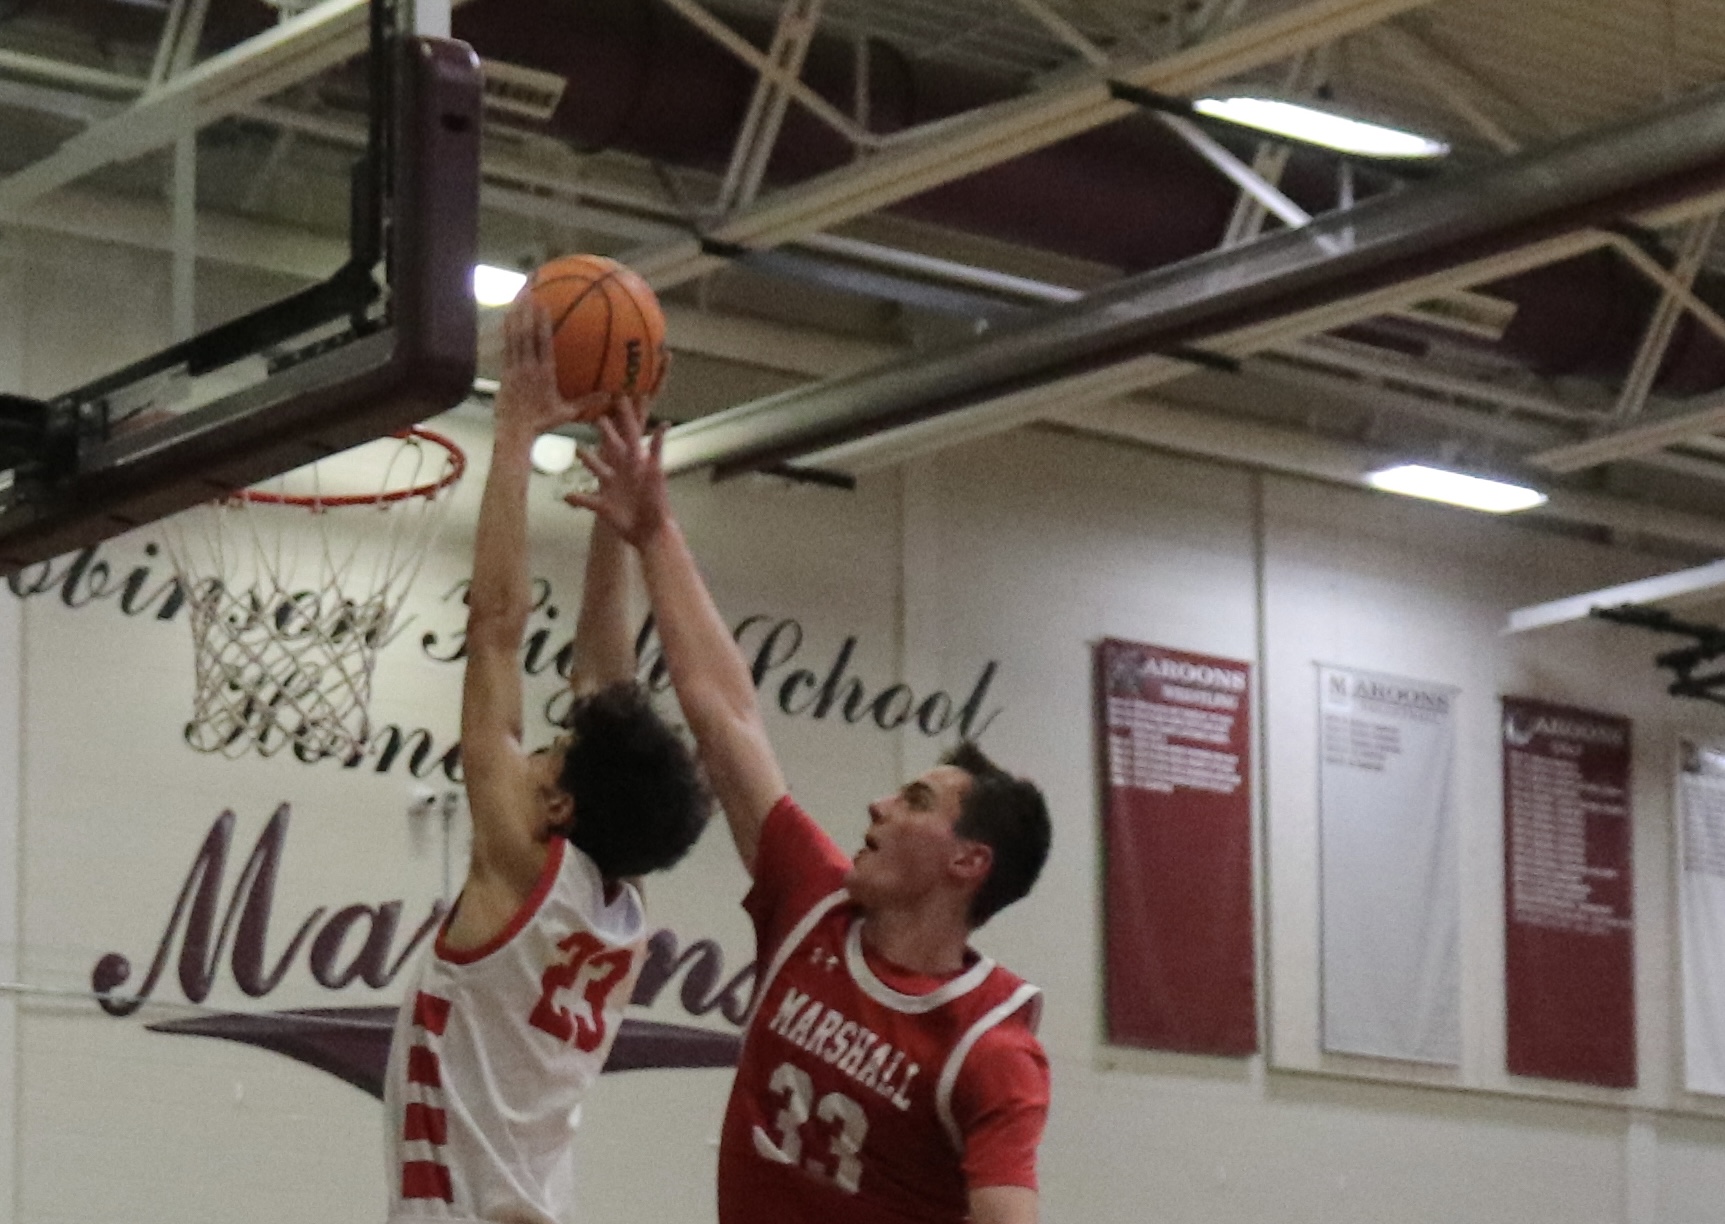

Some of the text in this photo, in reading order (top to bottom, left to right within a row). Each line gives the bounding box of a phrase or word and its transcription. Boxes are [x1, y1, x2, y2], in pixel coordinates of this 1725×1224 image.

[733, 613, 1003, 739] School
[529, 930, 634, 1053] 23
[769, 986, 920, 1112] MARSHALL
[752, 1061, 869, 1195] 33
